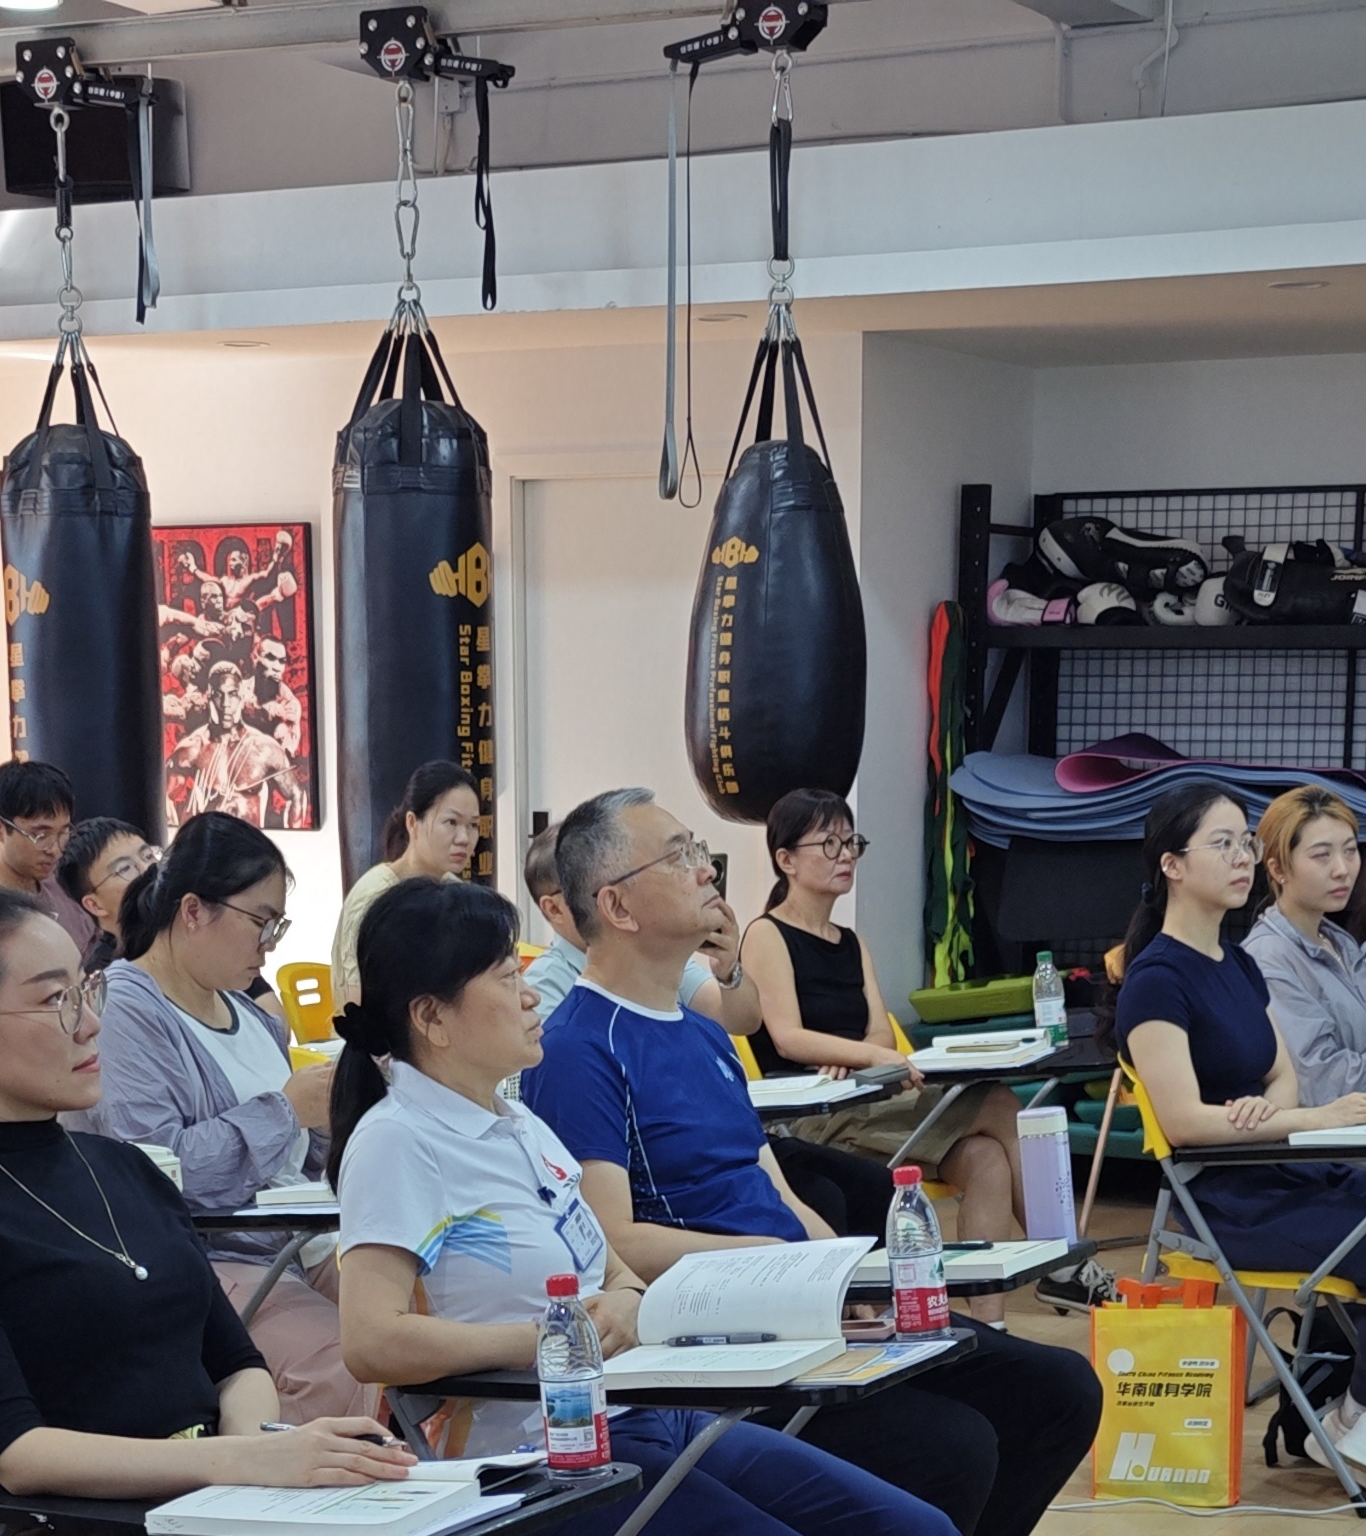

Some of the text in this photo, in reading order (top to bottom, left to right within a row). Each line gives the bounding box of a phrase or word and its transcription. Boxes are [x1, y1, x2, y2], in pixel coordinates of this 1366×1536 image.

[458, 624, 472, 665] Star
[457, 671, 474, 737] Boxing
[1115, 1381, 1213, 1398] 华南健身学院
